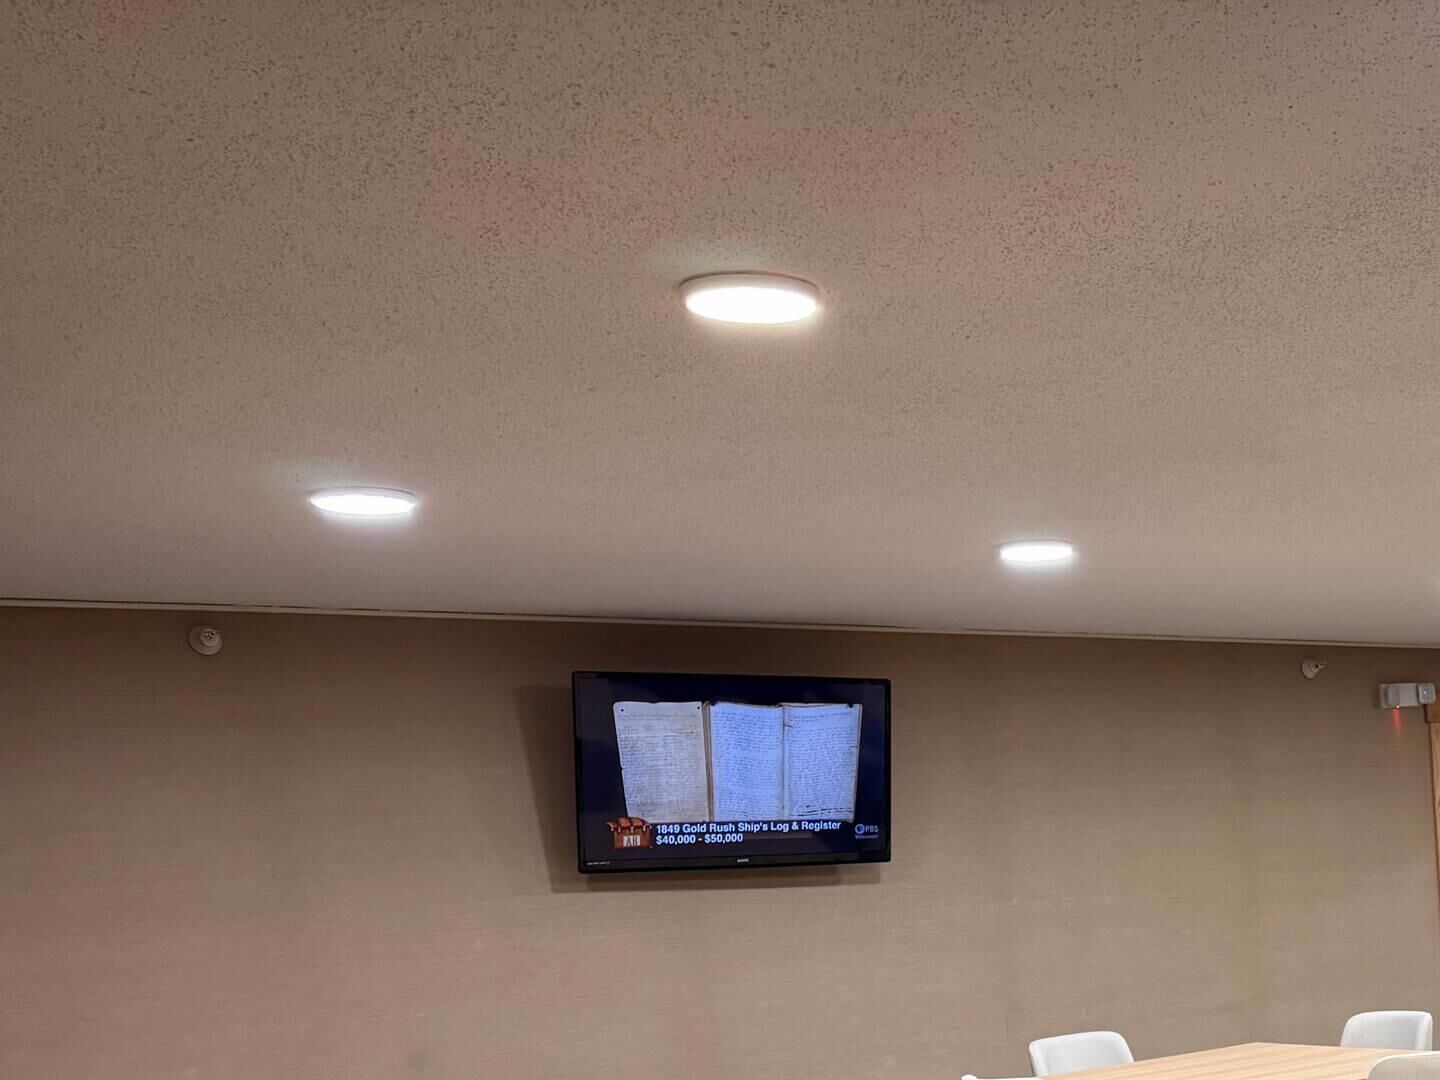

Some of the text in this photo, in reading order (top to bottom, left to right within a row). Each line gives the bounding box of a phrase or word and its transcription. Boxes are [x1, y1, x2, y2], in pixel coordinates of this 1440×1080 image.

[656, 820, 841, 834] 1849 Gold Rush Ship's Log & Register
[656, 834, 696, 846] $40,000
[704, 833, 743, 844] $50,000
